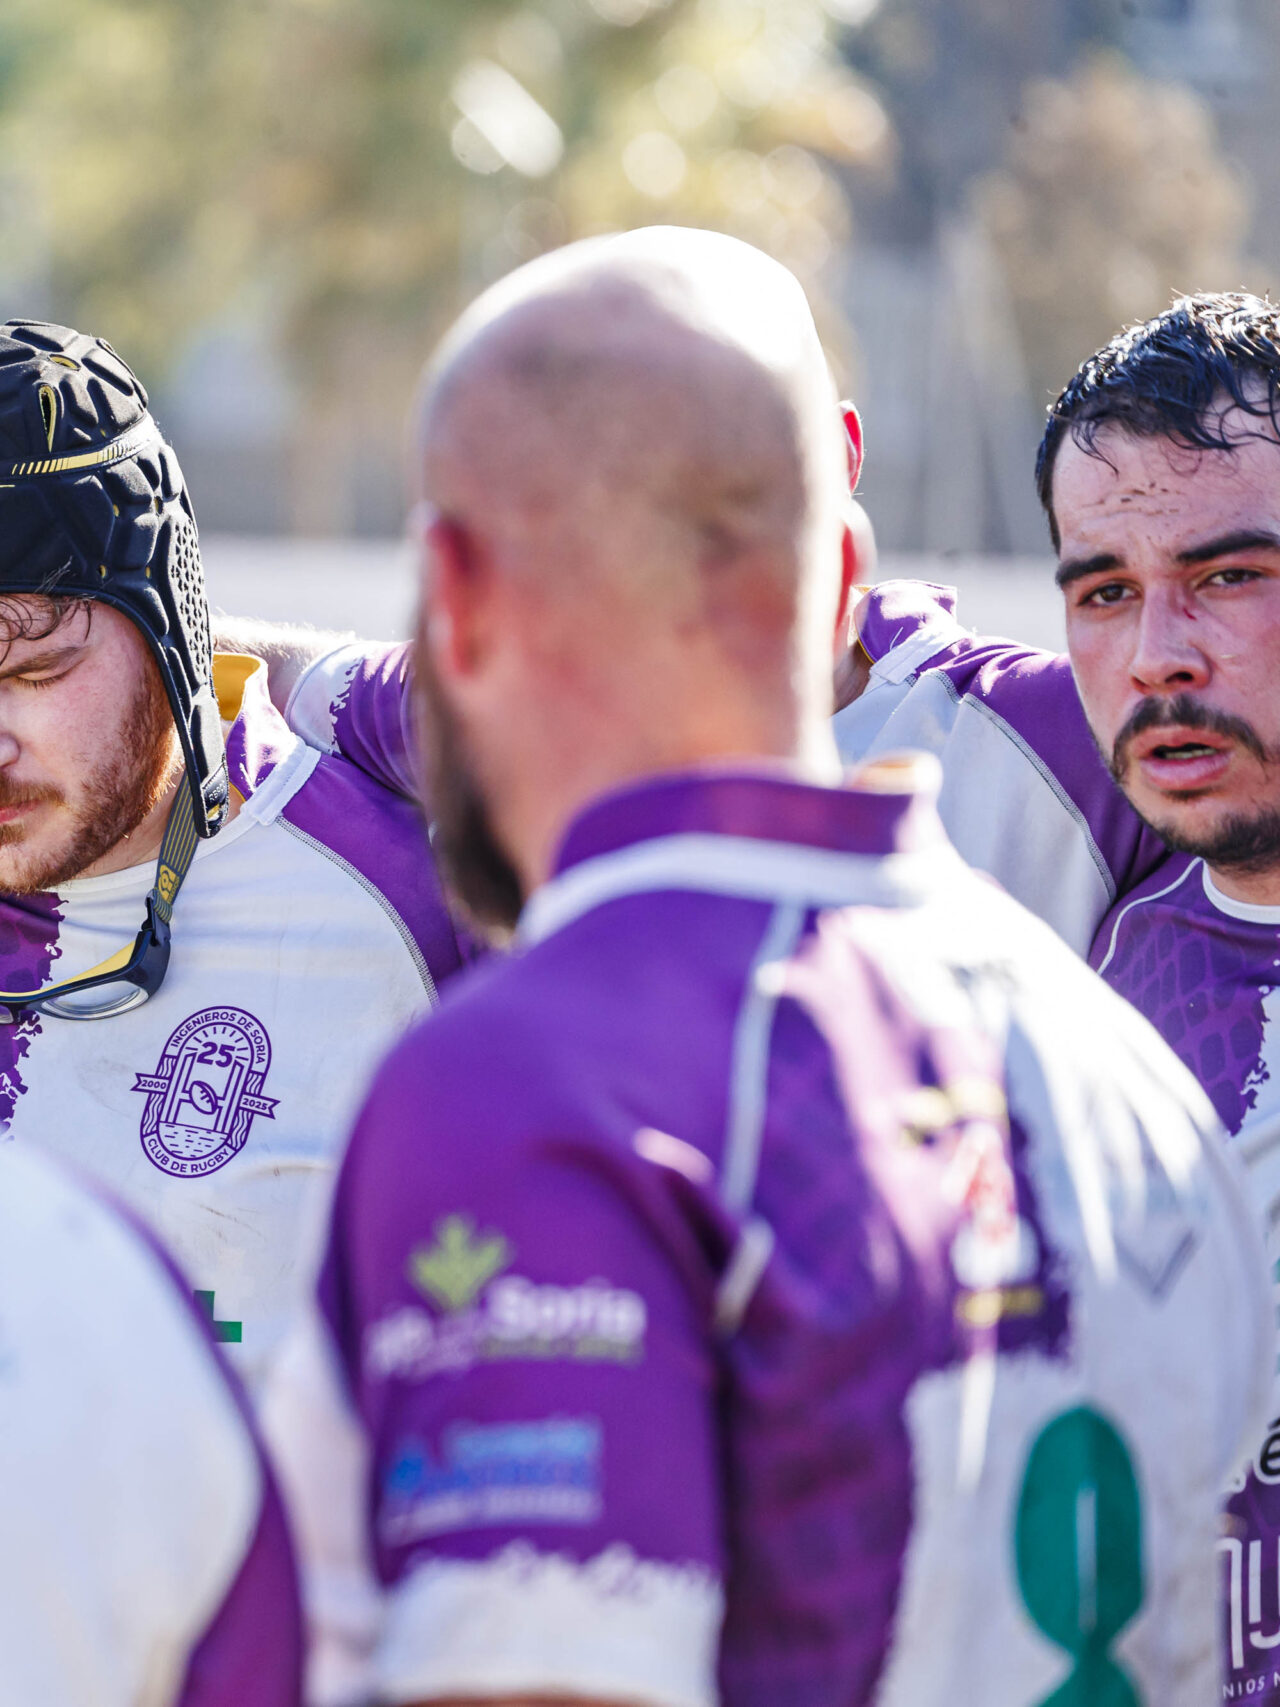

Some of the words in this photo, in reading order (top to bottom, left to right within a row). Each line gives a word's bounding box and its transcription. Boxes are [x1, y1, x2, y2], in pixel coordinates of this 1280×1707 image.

[170, 1011, 237, 1048] INGENIEROS
[237, 1016, 254, 1031] DE
[249, 1029, 266, 1064] SORIA
[196, 1041, 236, 1068] 25
[141, 1079, 167, 1090] 2000
[242, 1097, 268, 1111] 2025
[147, 1138, 170, 1166] CLUB
[170, 1160, 187, 1173] DE
[190, 1148, 230, 1173] RUGBY
